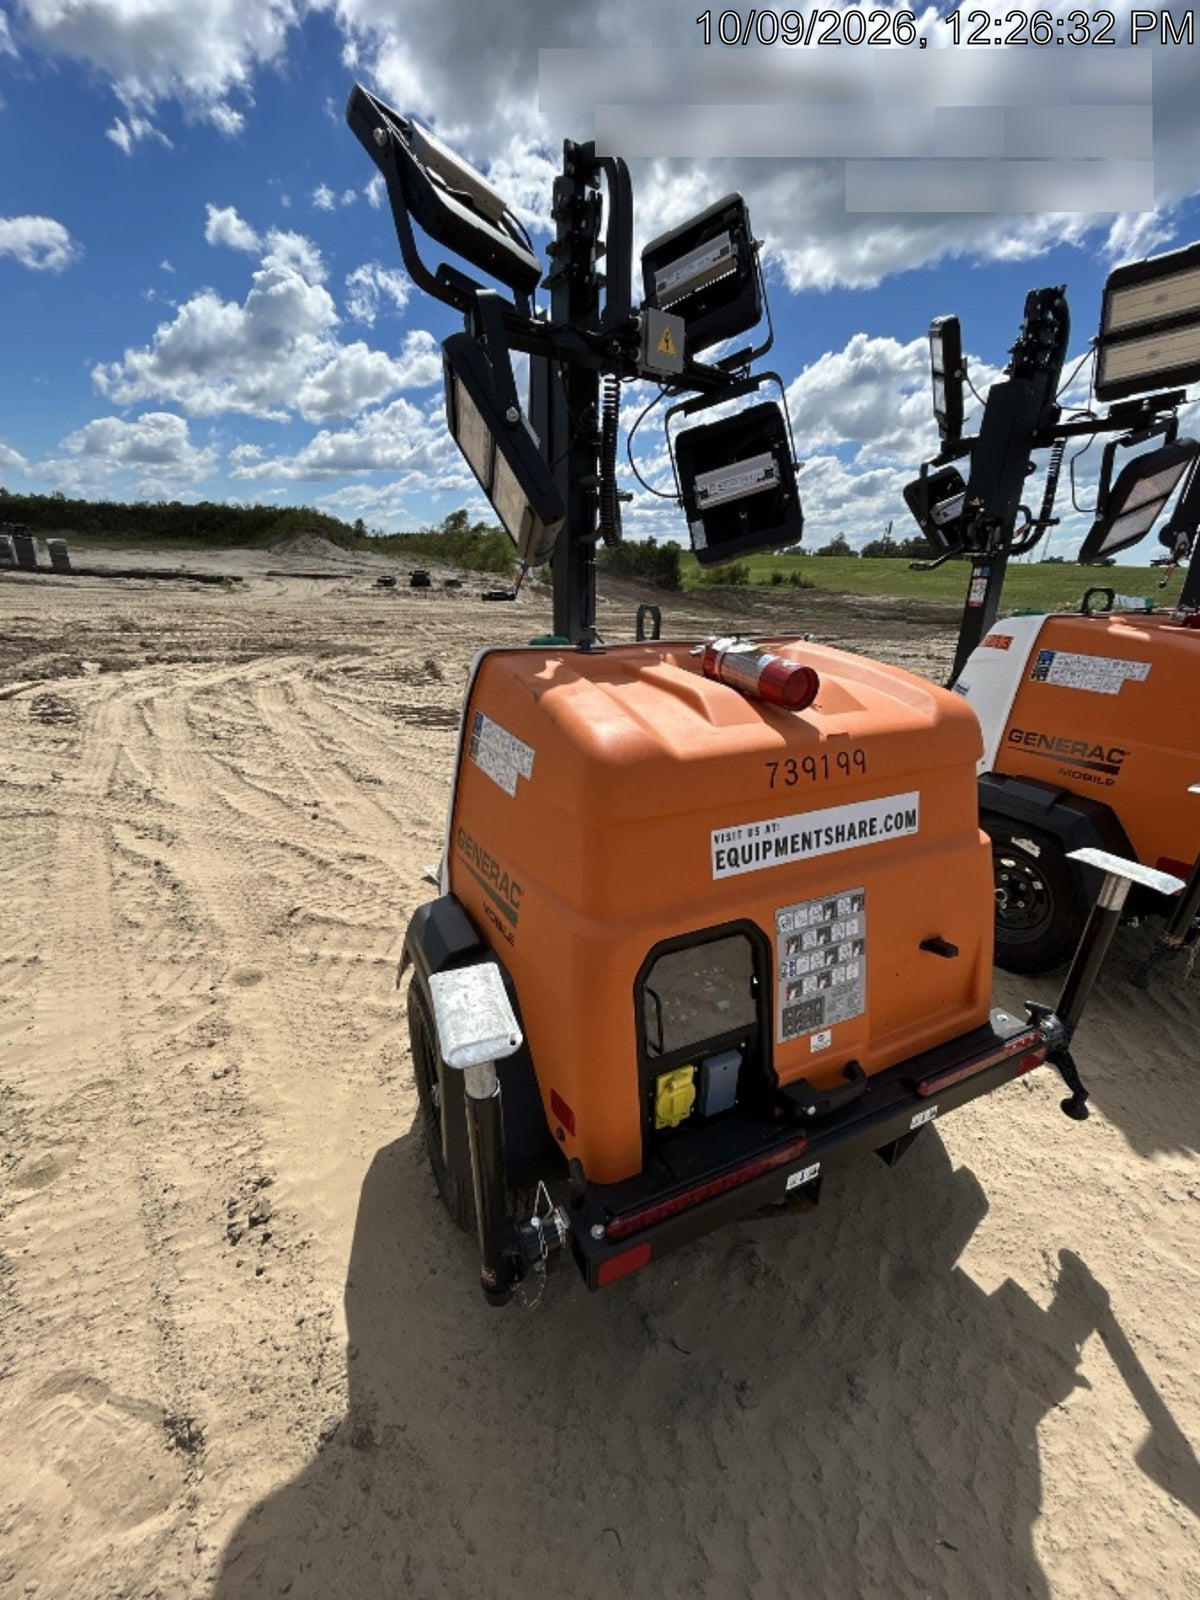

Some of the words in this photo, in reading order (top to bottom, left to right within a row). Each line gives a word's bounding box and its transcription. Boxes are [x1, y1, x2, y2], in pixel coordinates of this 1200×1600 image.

[1008, 728, 1126, 765] GENERAC
[765, 749, 867, 789] 739199
[1058, 767, 1116, 787] MOBILE
[714, 829, 743, 845] VISIT
[747, 827, 761, 839] US
[715, 808, 917, 871] EQUIPMENTSHARE.COM
[457, 827, 521, 910] GENERAC
